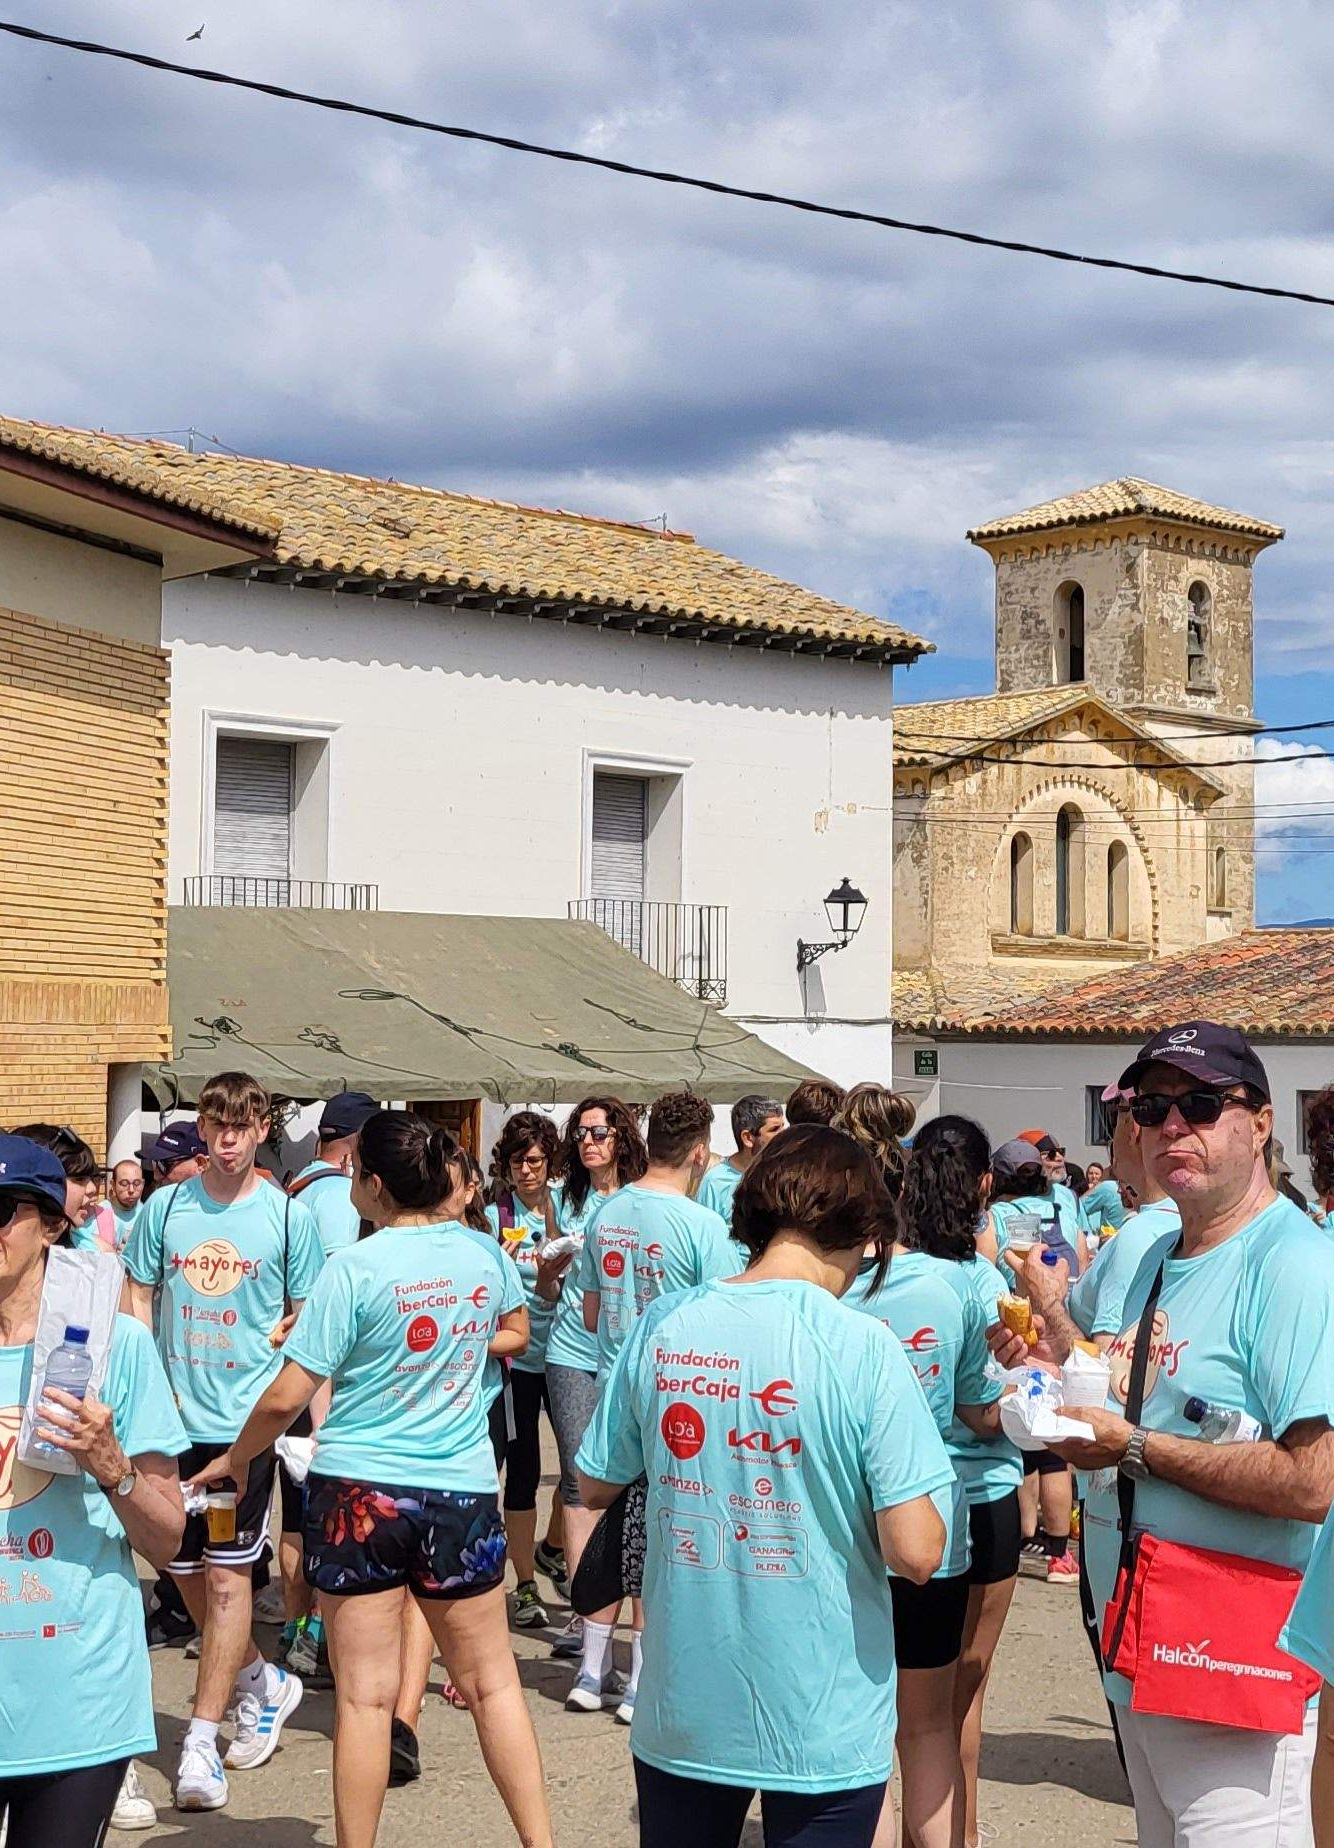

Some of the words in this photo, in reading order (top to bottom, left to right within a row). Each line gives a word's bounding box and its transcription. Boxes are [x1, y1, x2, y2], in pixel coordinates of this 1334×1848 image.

[1151, 1044, 1206, 1057] Mercedes-Benz
[599, 1224, 641, 1237] Fundación
[597, 1236, 640, 1252] iberCaja
[171, 1252, 263, 1281] +mayores
[394, 1278, 453, 1297] Fundación
[396, 1293, 458, 1314] iberCaja
[656, 1347, 740, 1371] Fundación
[728, 1494, 802, 1514] escanero
